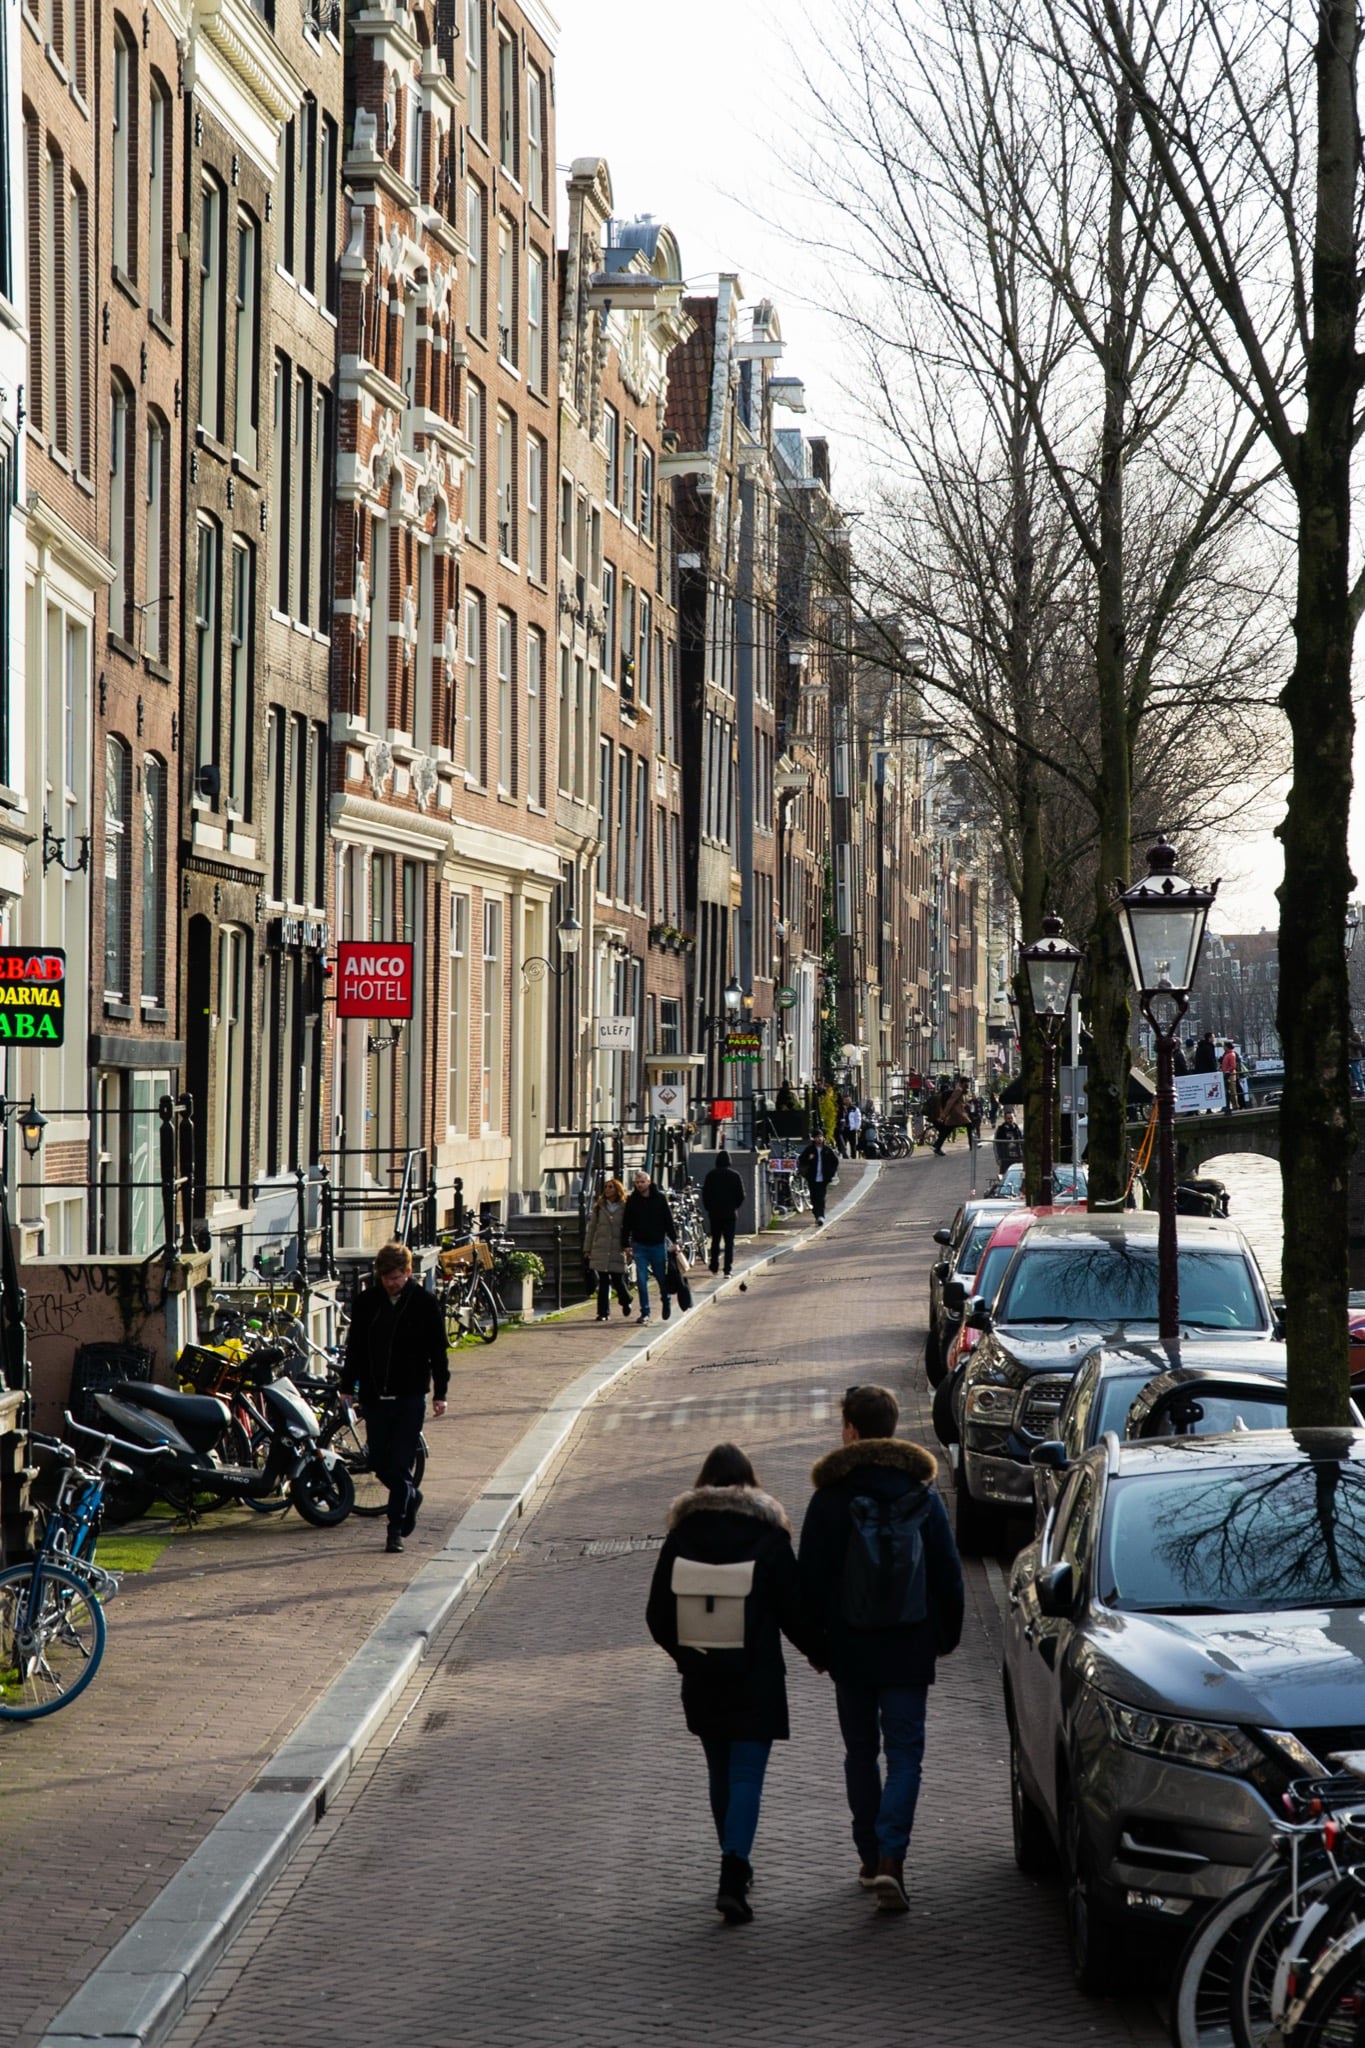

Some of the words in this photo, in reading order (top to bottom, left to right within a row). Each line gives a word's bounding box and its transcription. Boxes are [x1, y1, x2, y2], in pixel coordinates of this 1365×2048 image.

[344, 957, 405, 976] ANCO
[344, 980, 407, 1001] HOTEL
[600, 1025, 631, 1036] CLEFT
